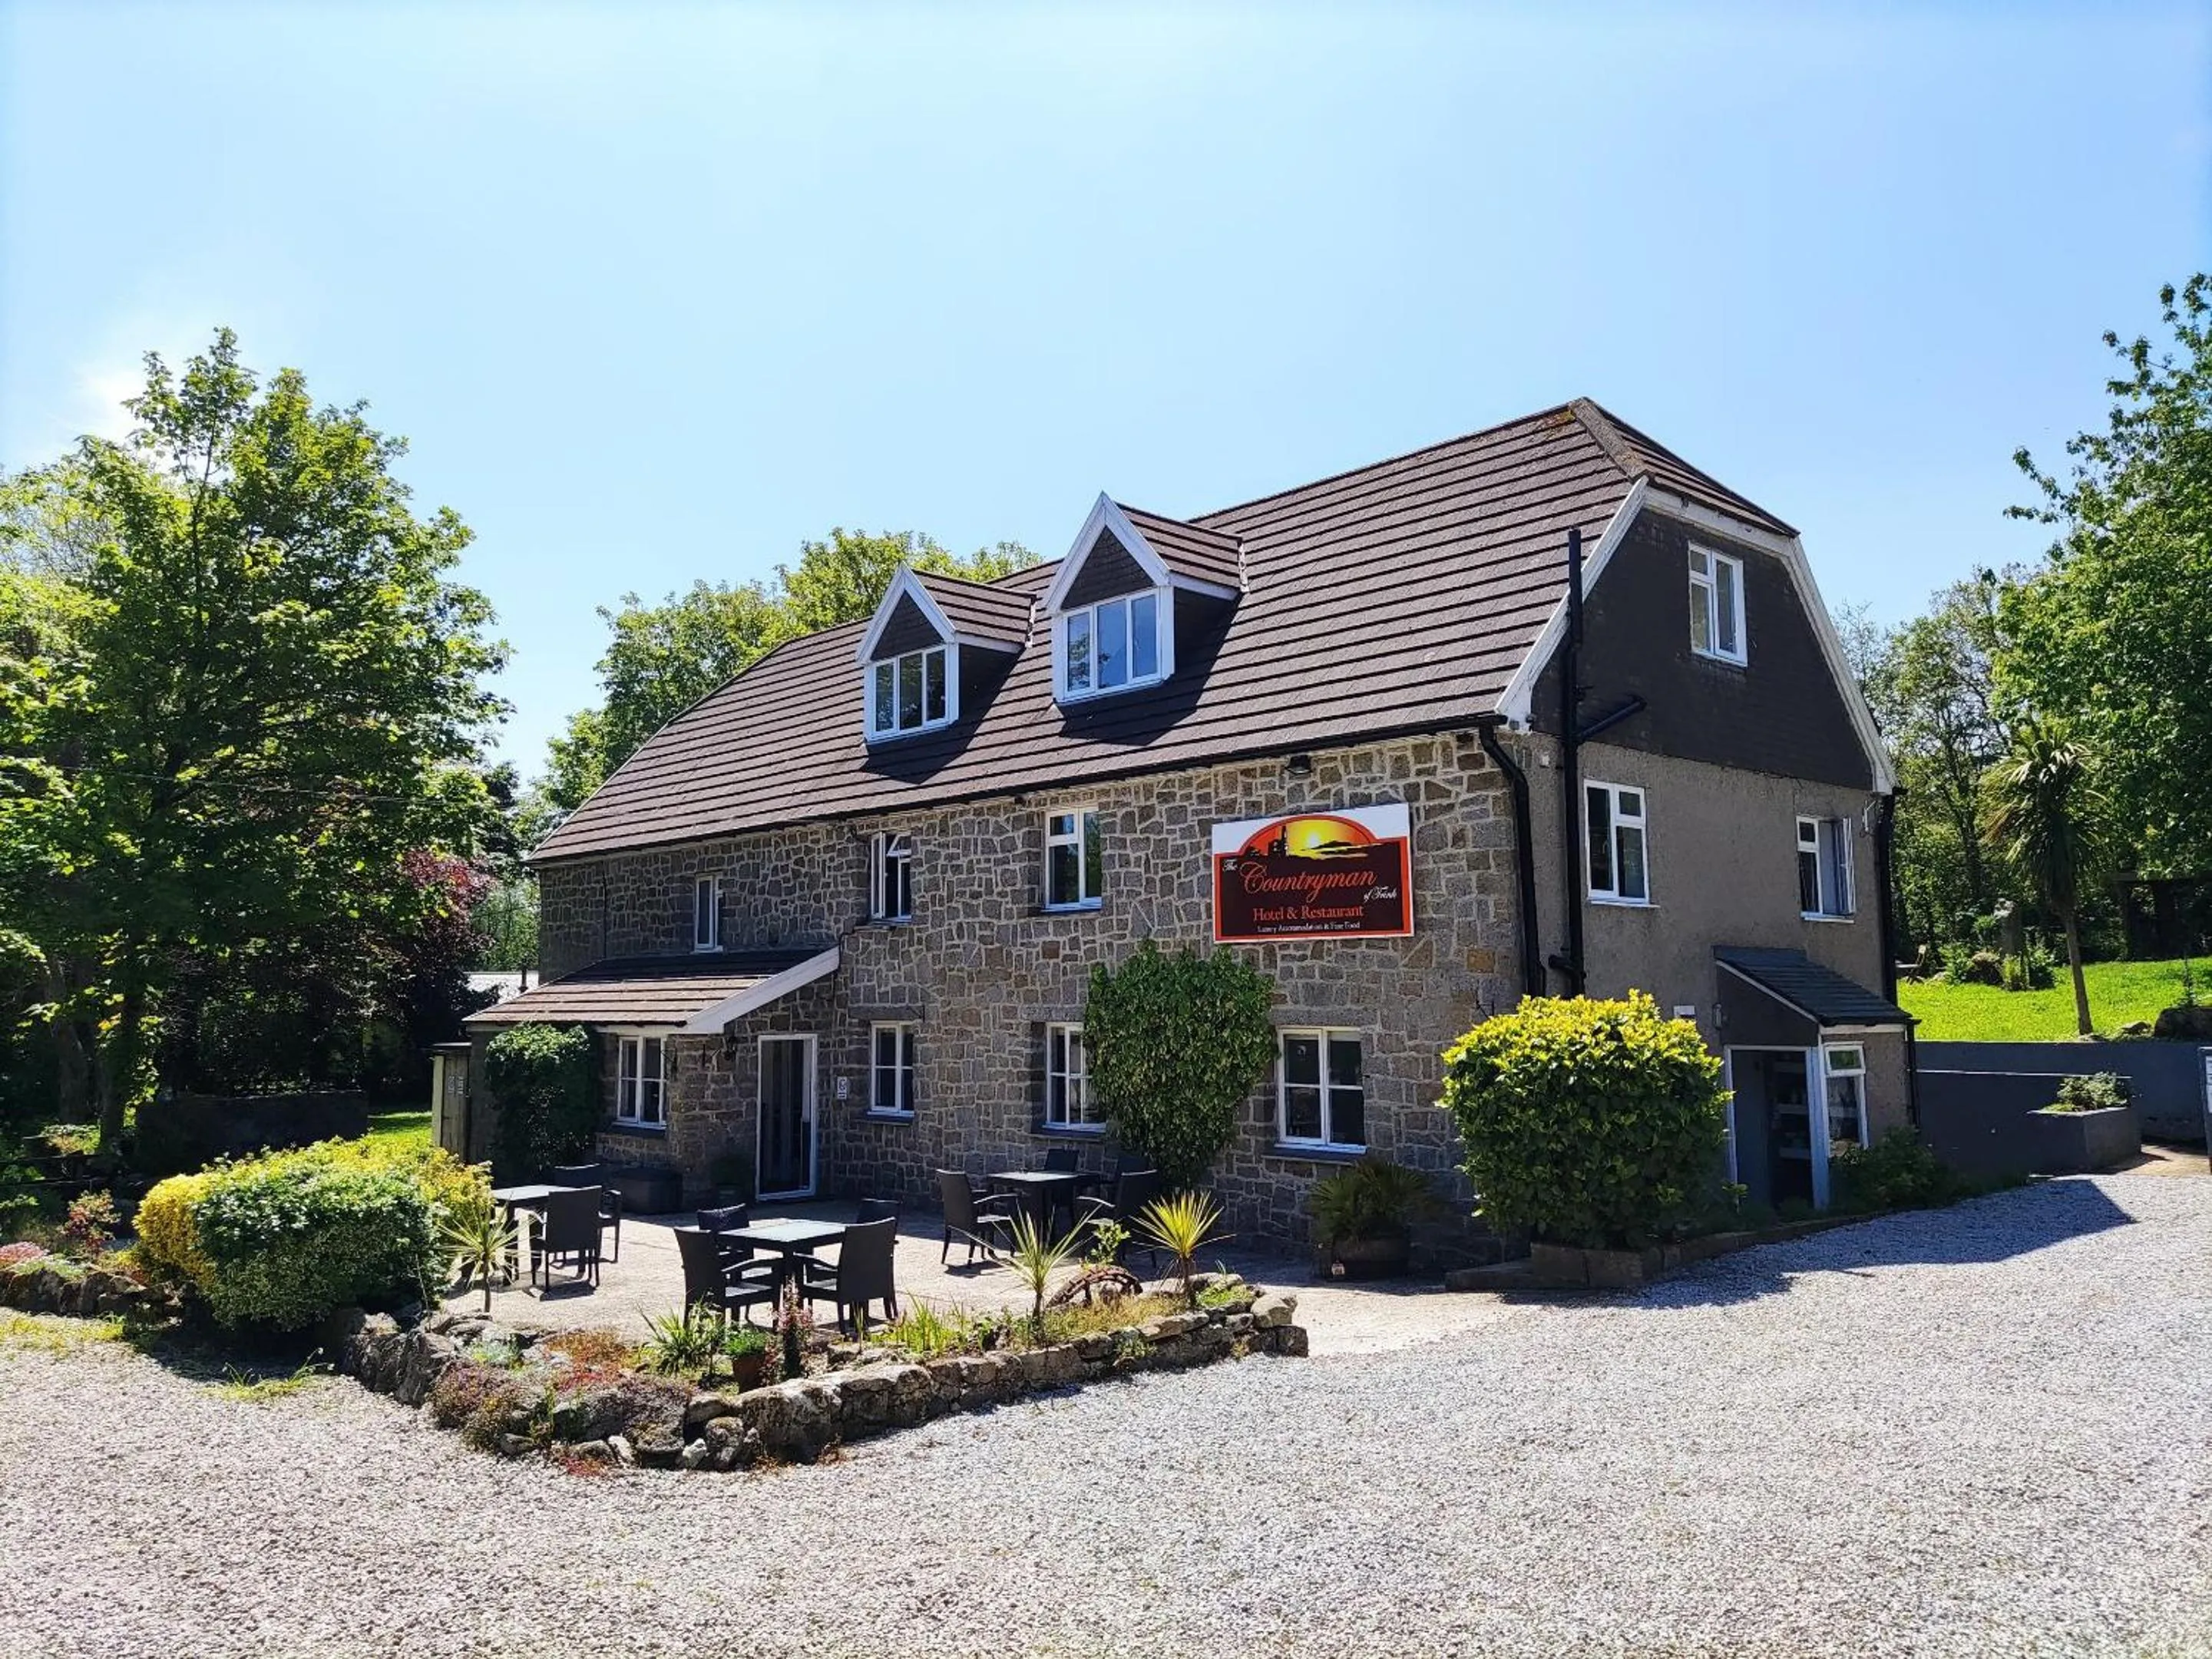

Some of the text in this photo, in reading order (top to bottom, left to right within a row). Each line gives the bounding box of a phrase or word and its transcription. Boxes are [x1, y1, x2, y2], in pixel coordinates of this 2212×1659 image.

[1240, 861, 1377, 903] Countryman
[1253, 905, 1364, 921] Hotel & Restaurant
